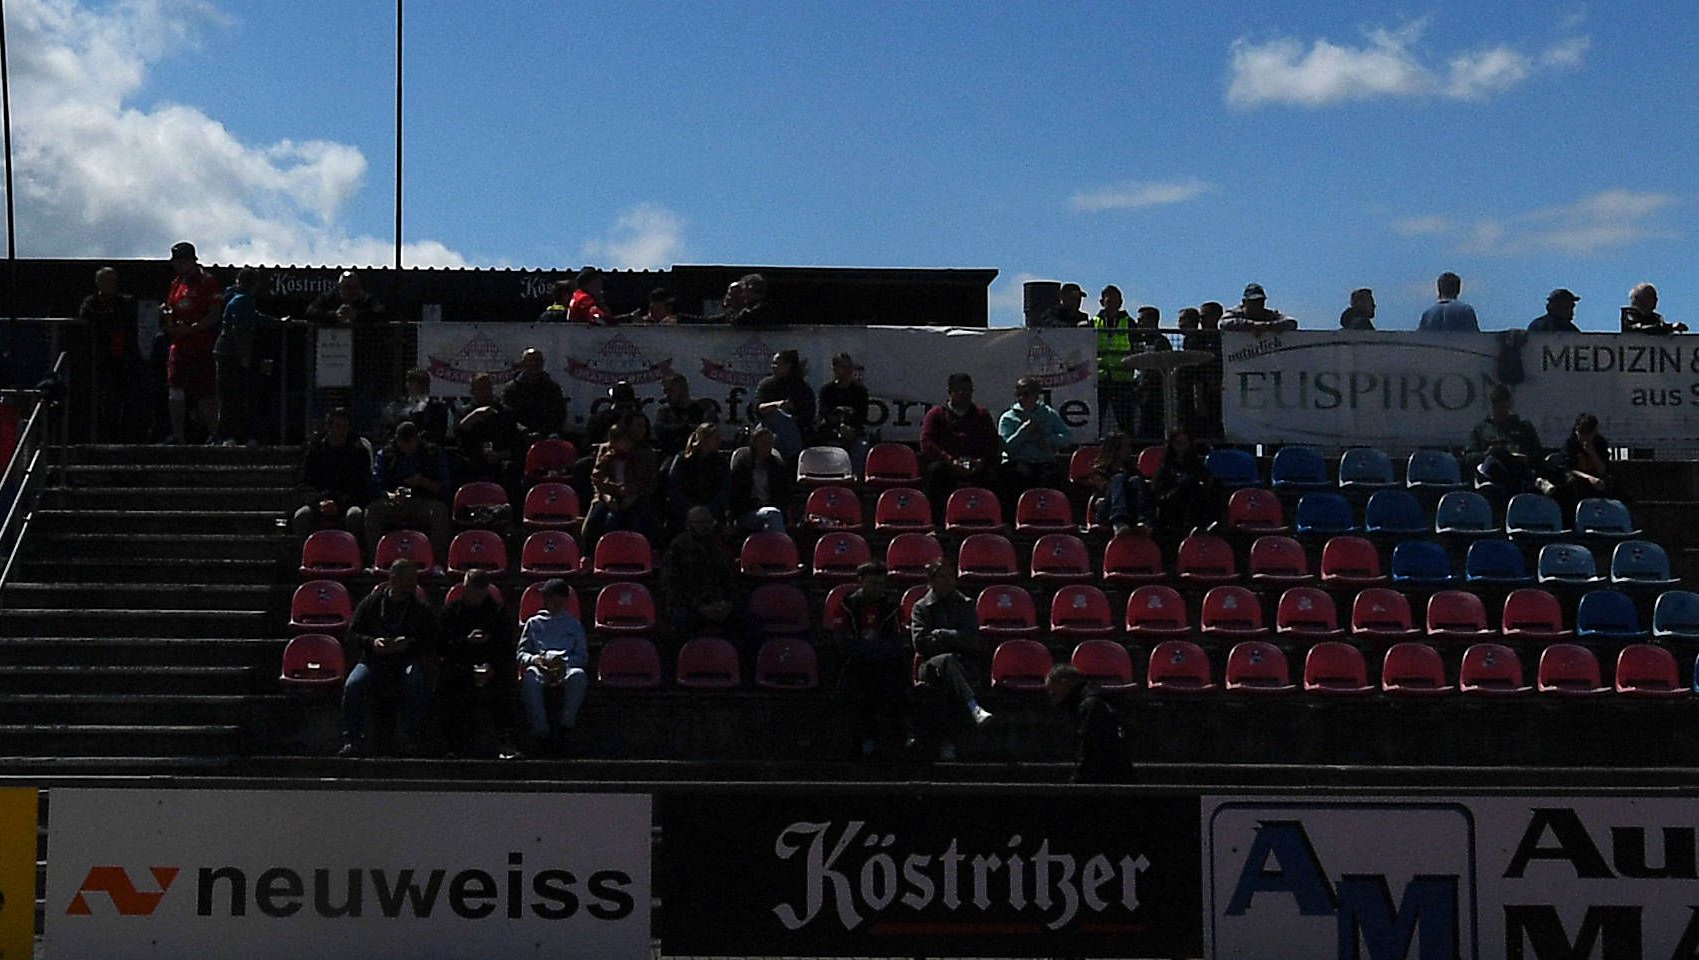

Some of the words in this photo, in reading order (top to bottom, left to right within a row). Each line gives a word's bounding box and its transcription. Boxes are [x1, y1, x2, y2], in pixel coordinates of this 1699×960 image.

[1542, 345, 1681, 374] MEDIZIN
[1631, 387, 1683, 407] aus
[196, 852, 636, 921] neuweiss
[771, 820, 1152, 932] Köstritzer
[1224, 819, 1461, 960] AM
